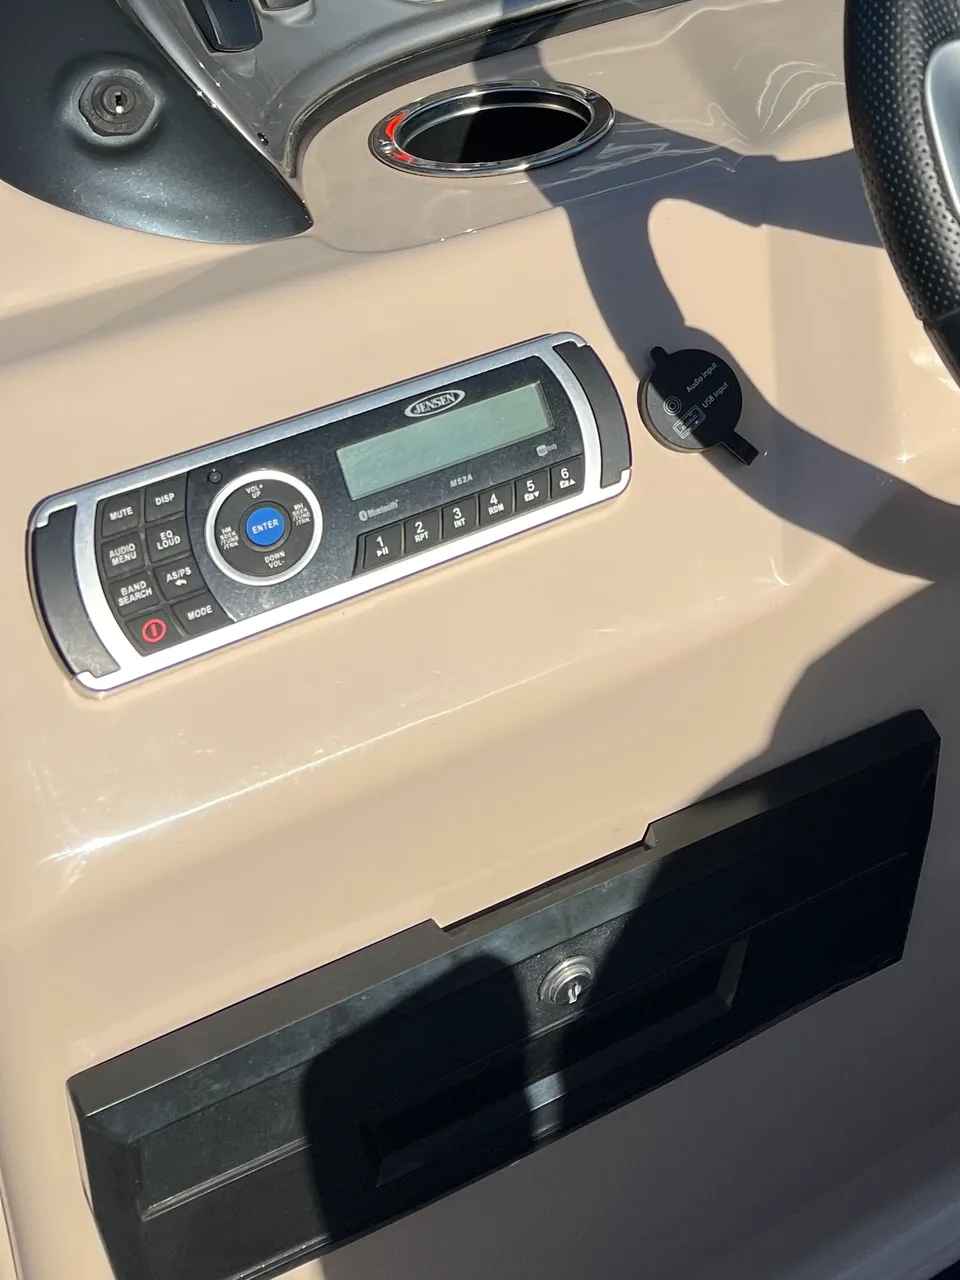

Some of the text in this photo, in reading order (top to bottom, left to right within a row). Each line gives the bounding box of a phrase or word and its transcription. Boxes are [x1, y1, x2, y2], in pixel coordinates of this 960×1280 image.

[686, 362, 718, 393] Audio Input
[701, 382, 729, 408] USB Input
[414, 392, 455, 414] JENSEN
[450, 473, 473, 488] MS2A
[560, 468, 569, 479] 6
[526, 480, 535, 492] 5
[155, 492, 175, 505] DISP
[251, 491, 261, 499] UP
[490, 493, 498, 505] 4
[109, 507, 133, 520] MUTE
[367, 501, 398, 518] Bluetooth
[453, 508, 462, 519] 3
[488, 503, 504, 515] RDM
[251, 518, 279, 534] ENTER
[414, 522, 424, 533] 2
[454, 517, 466, 528] INT
[156, 535, 180, 550] LOUD
[160, 530, 174, 541] EQ
[376, 536, 384, 547] 1
[414, 531, 429, 543] RPT
[109, 543, 135, 558] AUDIO
[264, 550, 285, 564] DOWN
[111, 551, 137, 566] MENU
[166, 567, 191, 582] AS/PS
[120, 580, 147, 596] BAND
[118, 588, 152, 606] SEARCH
[187, 605, 213, 620] MODE
